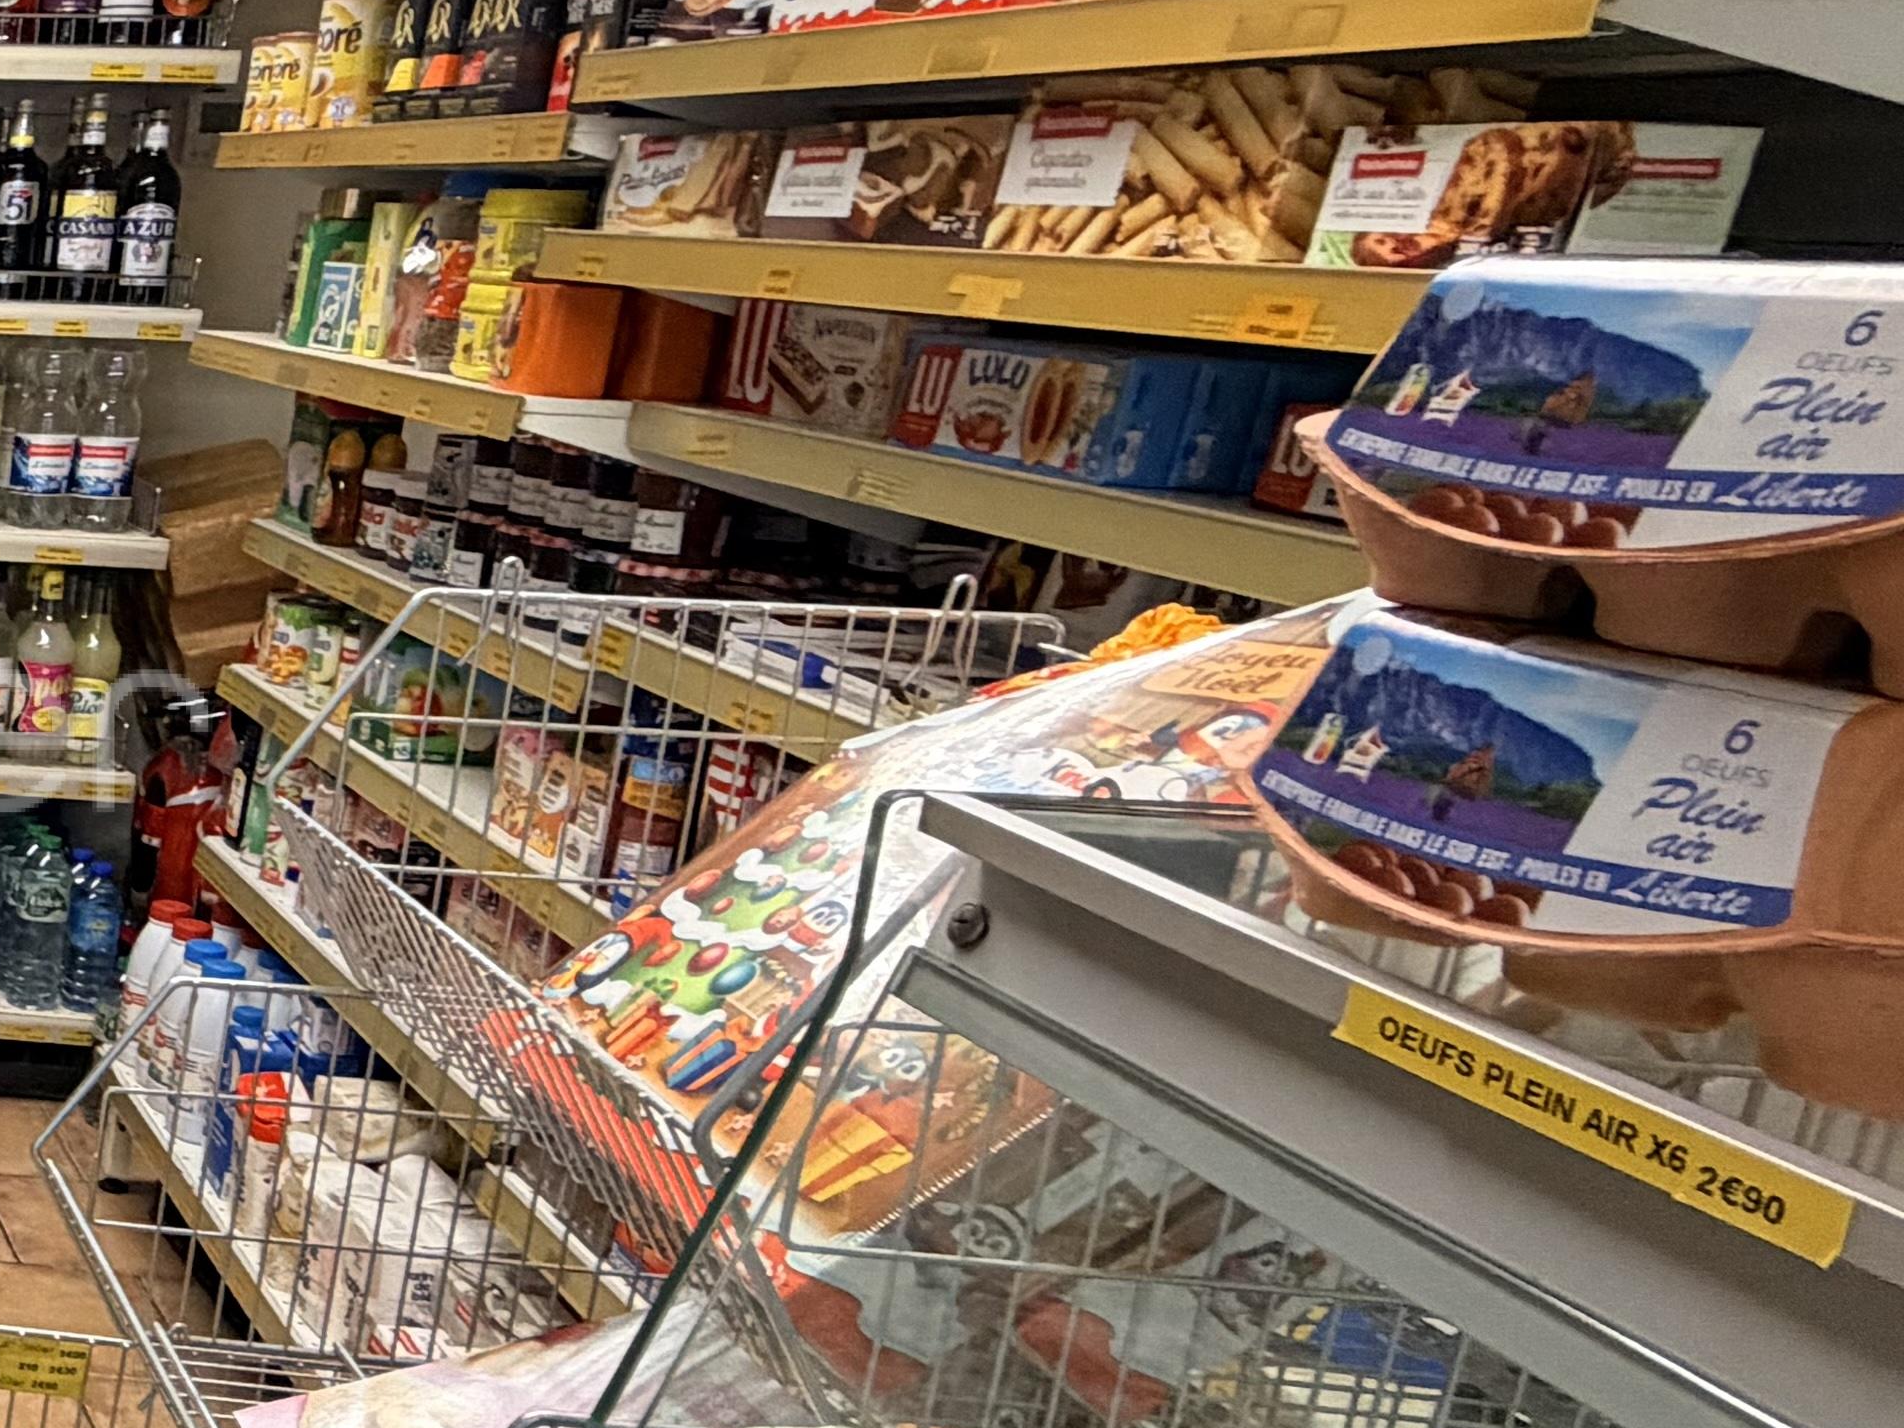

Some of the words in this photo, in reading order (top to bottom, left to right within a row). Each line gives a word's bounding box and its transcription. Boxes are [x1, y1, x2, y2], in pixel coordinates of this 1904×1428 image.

[122, 218, 177, 237] AZUR
[1842, 310, 1882, 348] 6
[1751, 377, 1889, 427] Plein
[1755, 428, 1833, 463] air
[1722, 719, 1762, 756] 6
[1632, 775, 1766, 836] Plein
[1645, 826, 1716, 867] air
[1377, 1014, 1477, 1079] OEUFS
[1482, 1060, 1578, 1125] PLEIN
[1580, 1107, 1640, 1154] AIR
[1645, 1131, 1690, 1174] X6
[1692, 1165, 1787, 1228] 2€90
